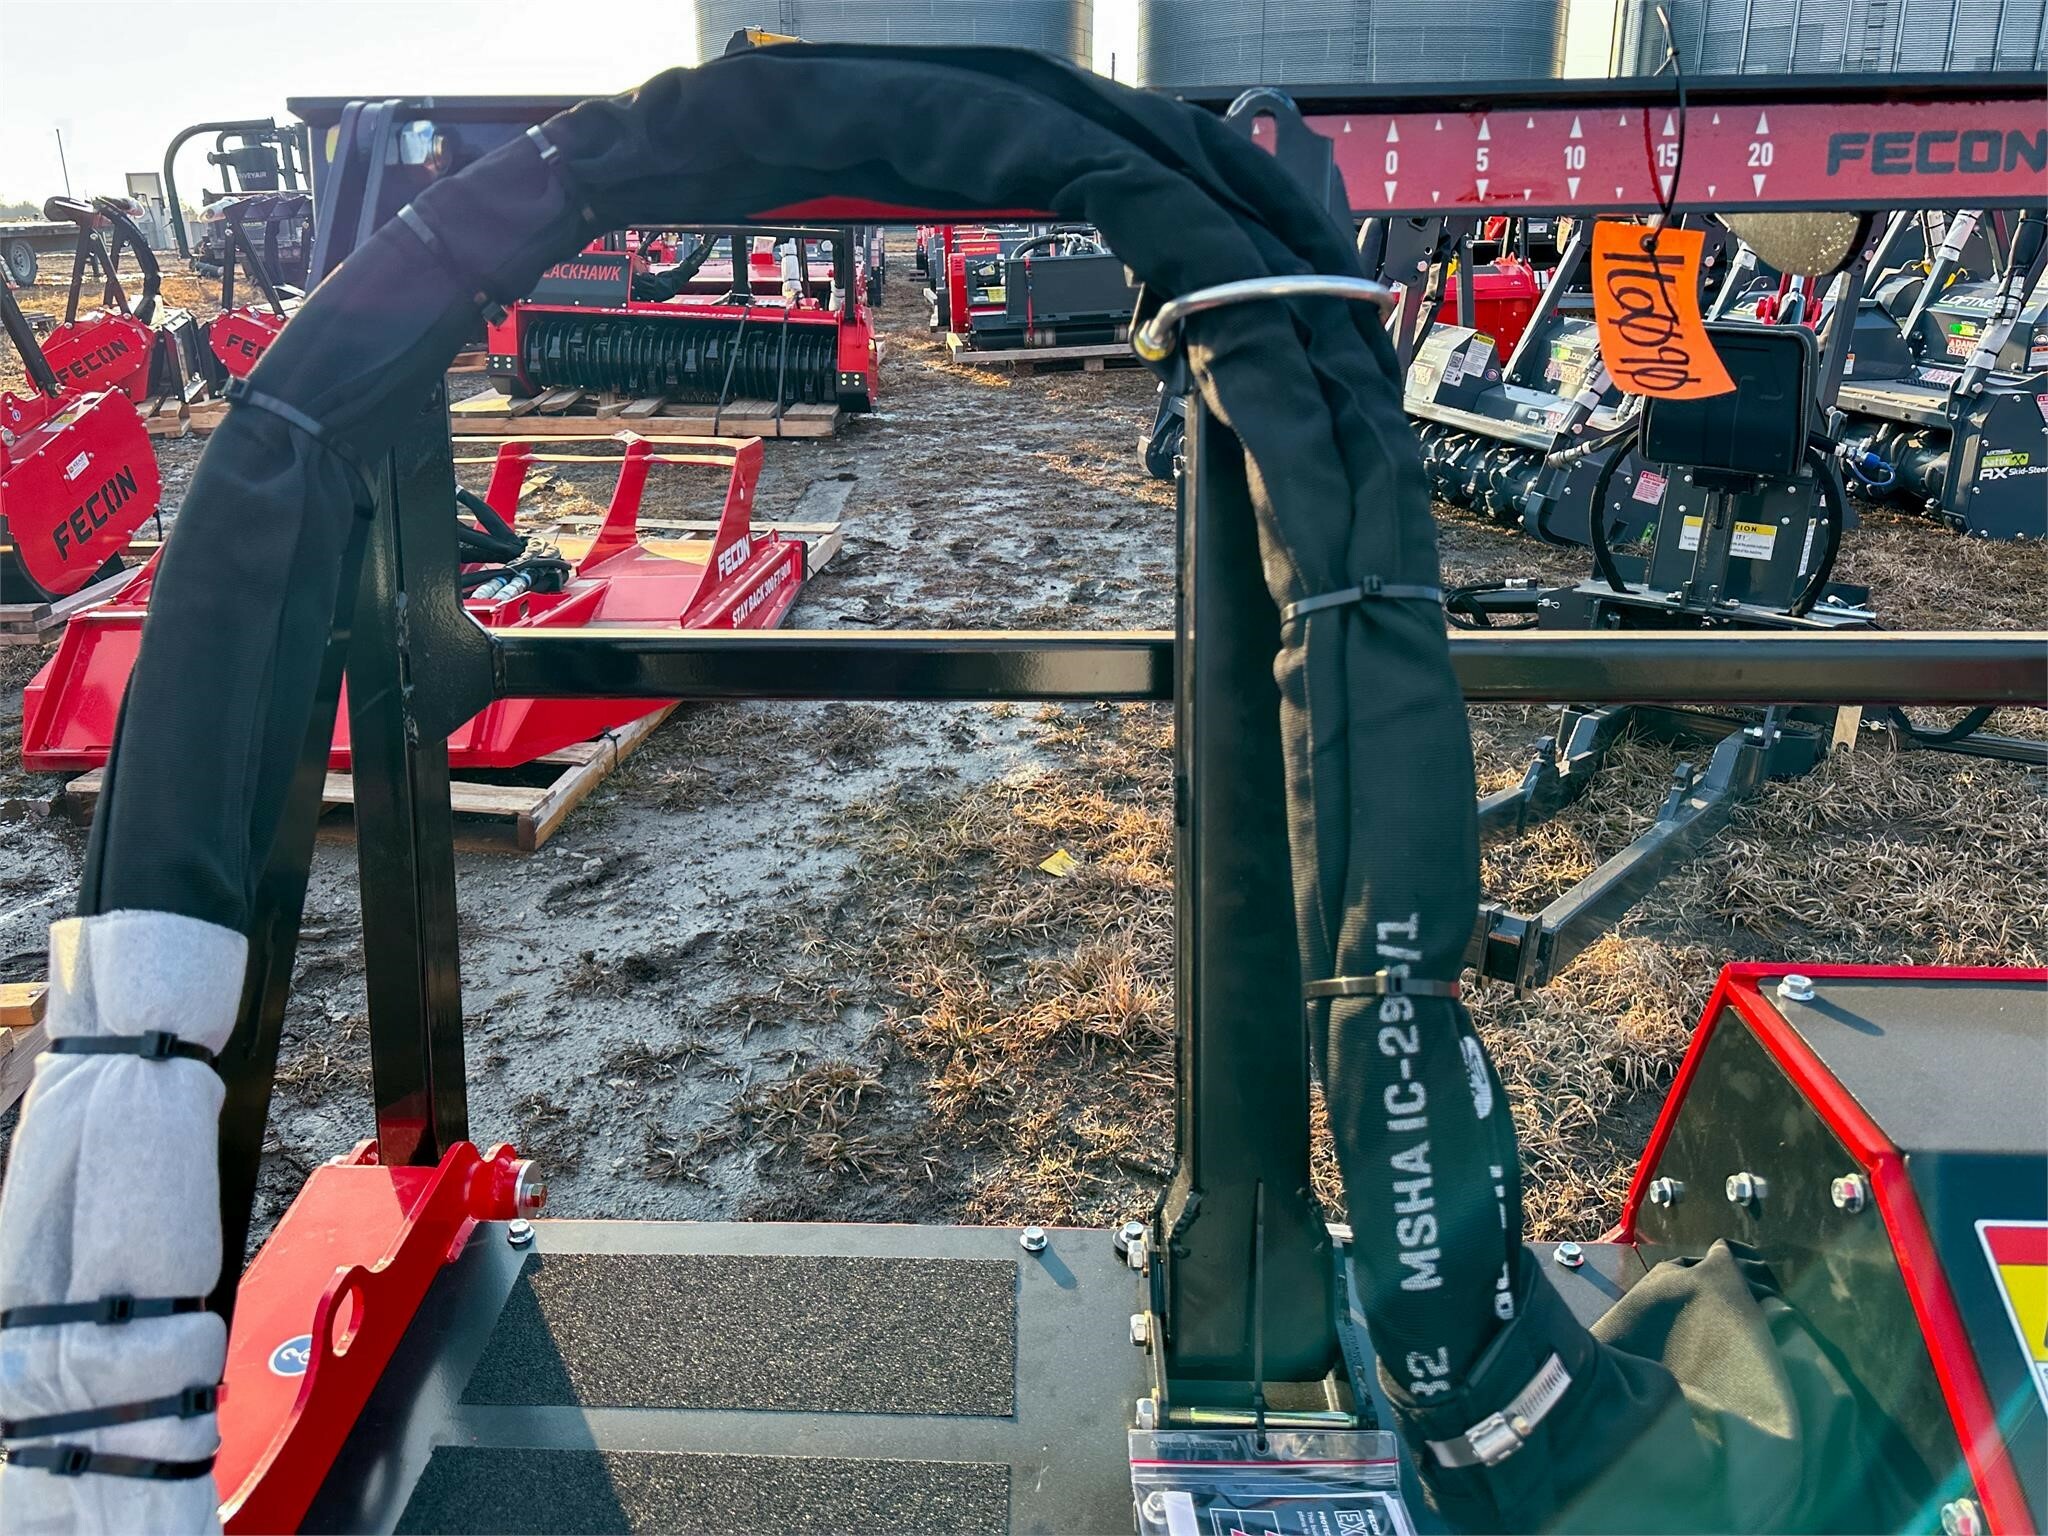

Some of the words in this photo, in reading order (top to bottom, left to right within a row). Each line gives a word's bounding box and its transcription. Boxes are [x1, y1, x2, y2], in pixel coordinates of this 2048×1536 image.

[1386, 150, 1398, 175] 0
[1476, 147, 1489, 172] 5
[1564, 145, 1586, 170] 10
[1656, 143, 1679, 168] 15
[1748, 141, 1774, 167] 20
[1827, 129, 2048, 176] FECON
[56, 338, 129, 384] FECON
[1979, 466, 2010, 480] AX
[52, 465, 138, 561] FECON
[718, 533, 751, 582] FECON
[732, 600, 750, 629] STAY
[748, 584, 765, 613] BACK
[1391, 1140, 1444, 1292] MSHA
